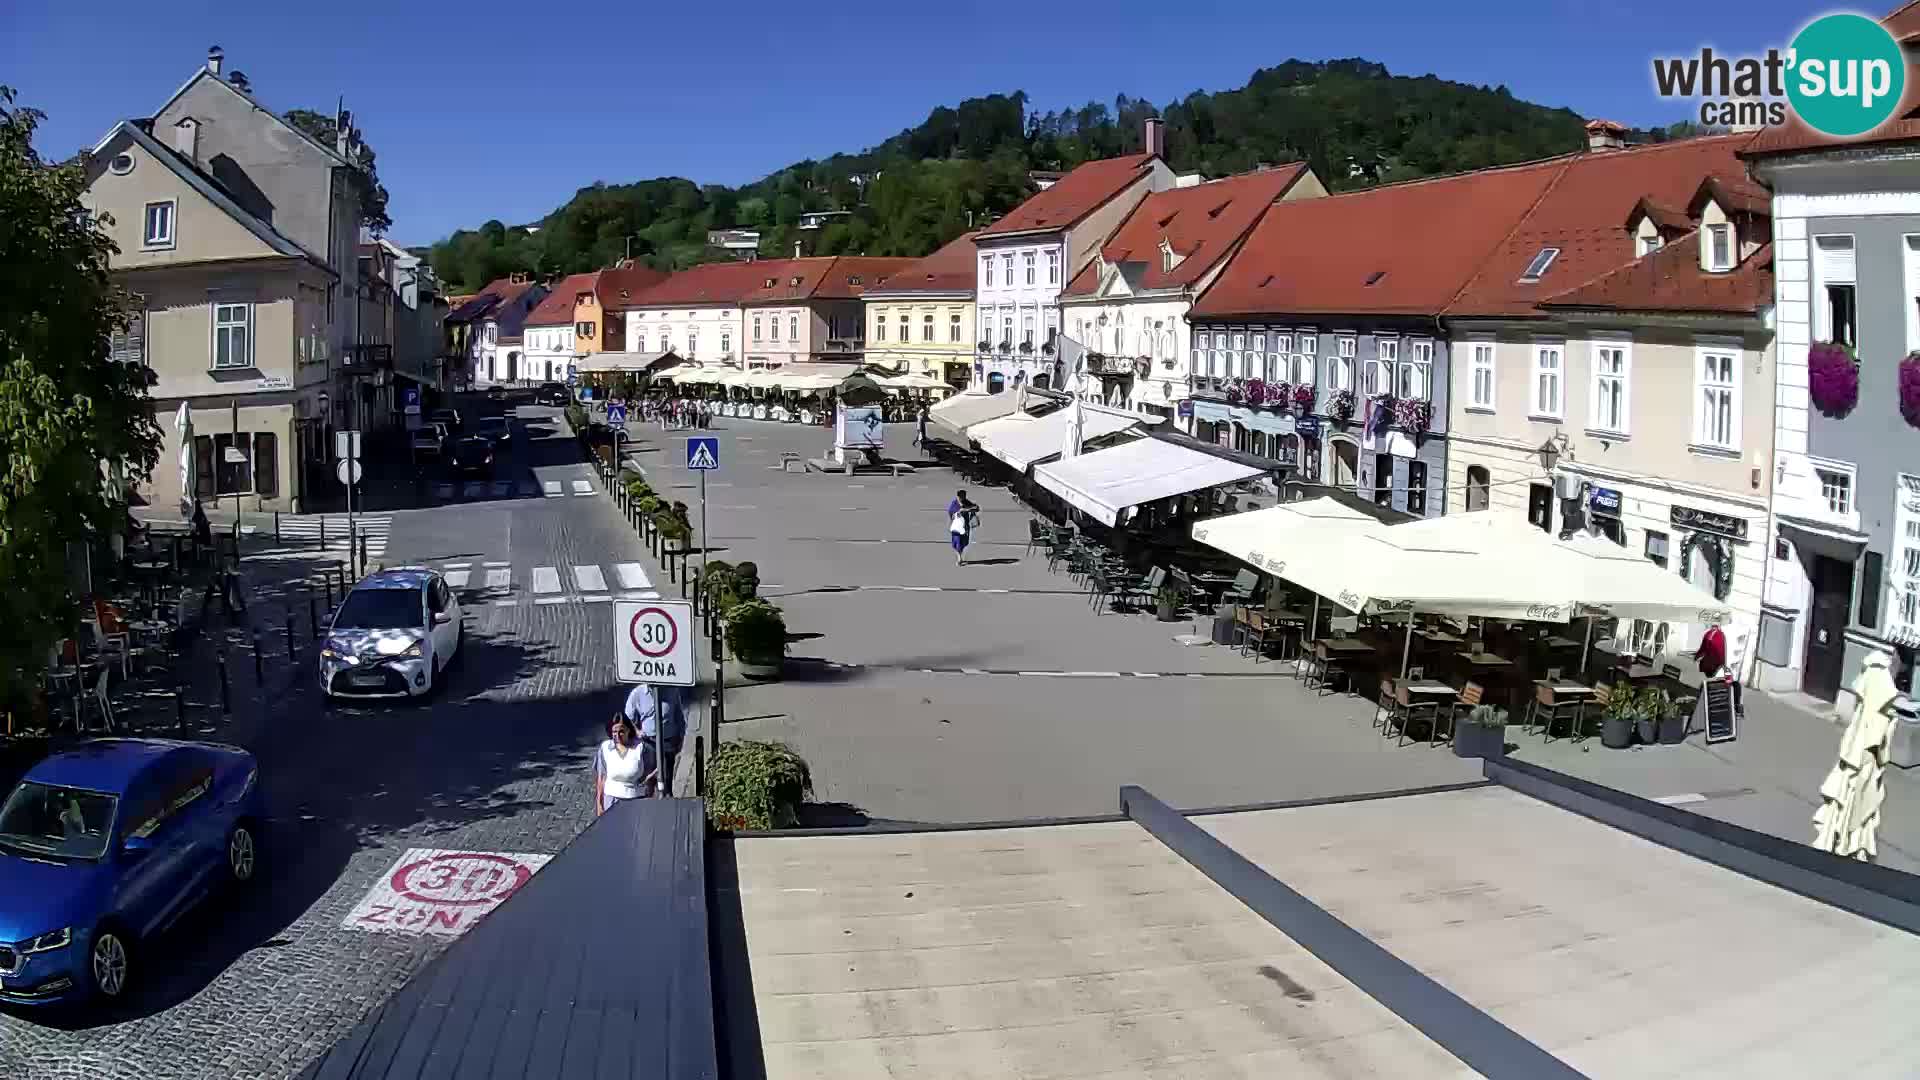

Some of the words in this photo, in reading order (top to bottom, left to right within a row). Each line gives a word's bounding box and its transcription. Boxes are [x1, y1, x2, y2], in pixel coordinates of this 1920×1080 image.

[642, 623, 666, 645] 30
[632, 660, 677, 677] ZONA
[418, 865, 504, 894] 30
[358, 904, 464, 929] ZON
